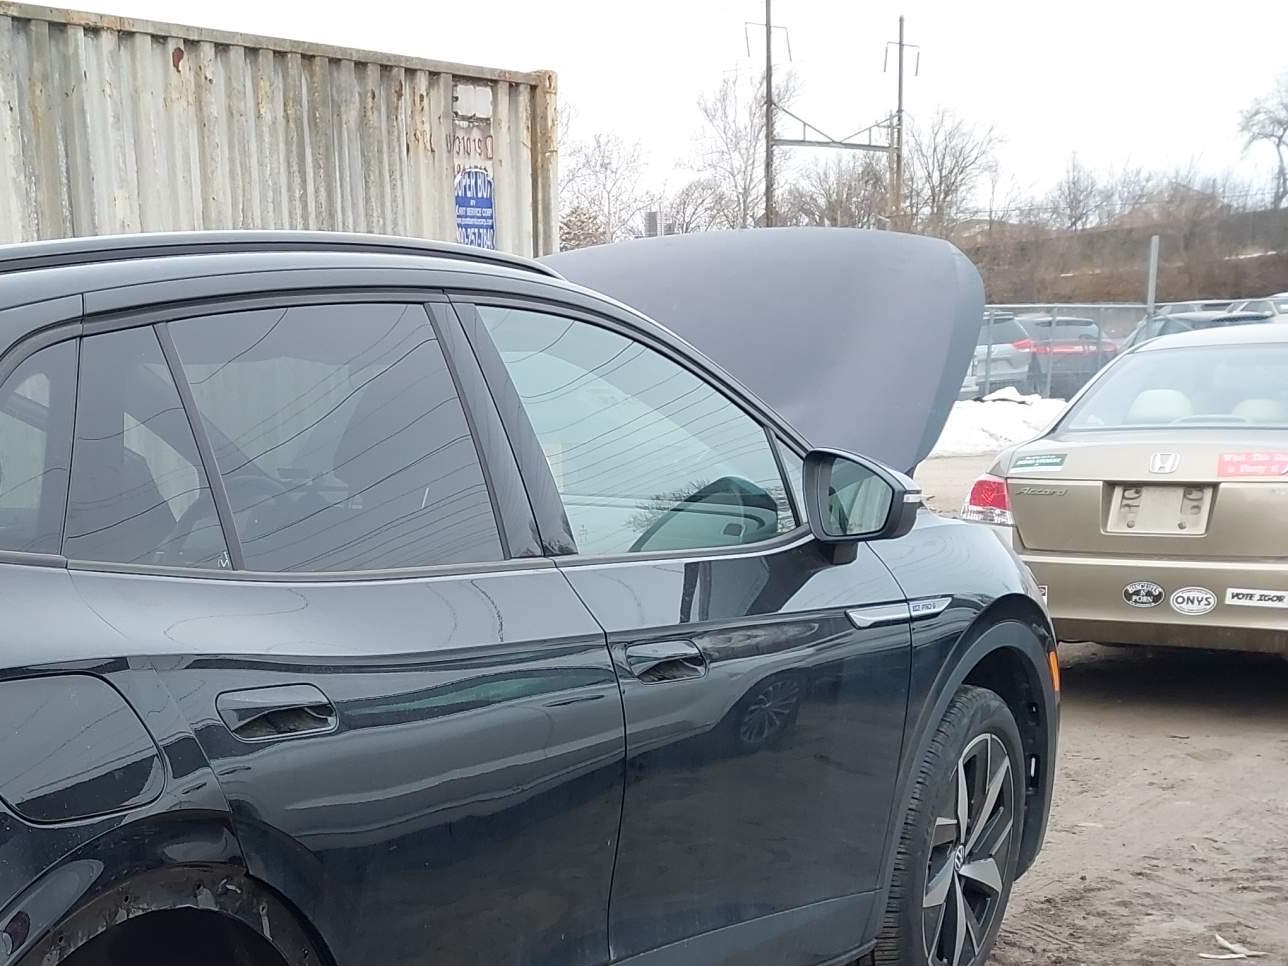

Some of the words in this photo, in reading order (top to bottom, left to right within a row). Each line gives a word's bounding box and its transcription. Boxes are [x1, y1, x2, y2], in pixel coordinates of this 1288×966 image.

[1175, 595, 1212, 606] ONYS
[1231, 592, 1256, 600] VOTE
[1256, 594, 1286, 602] IGOR
